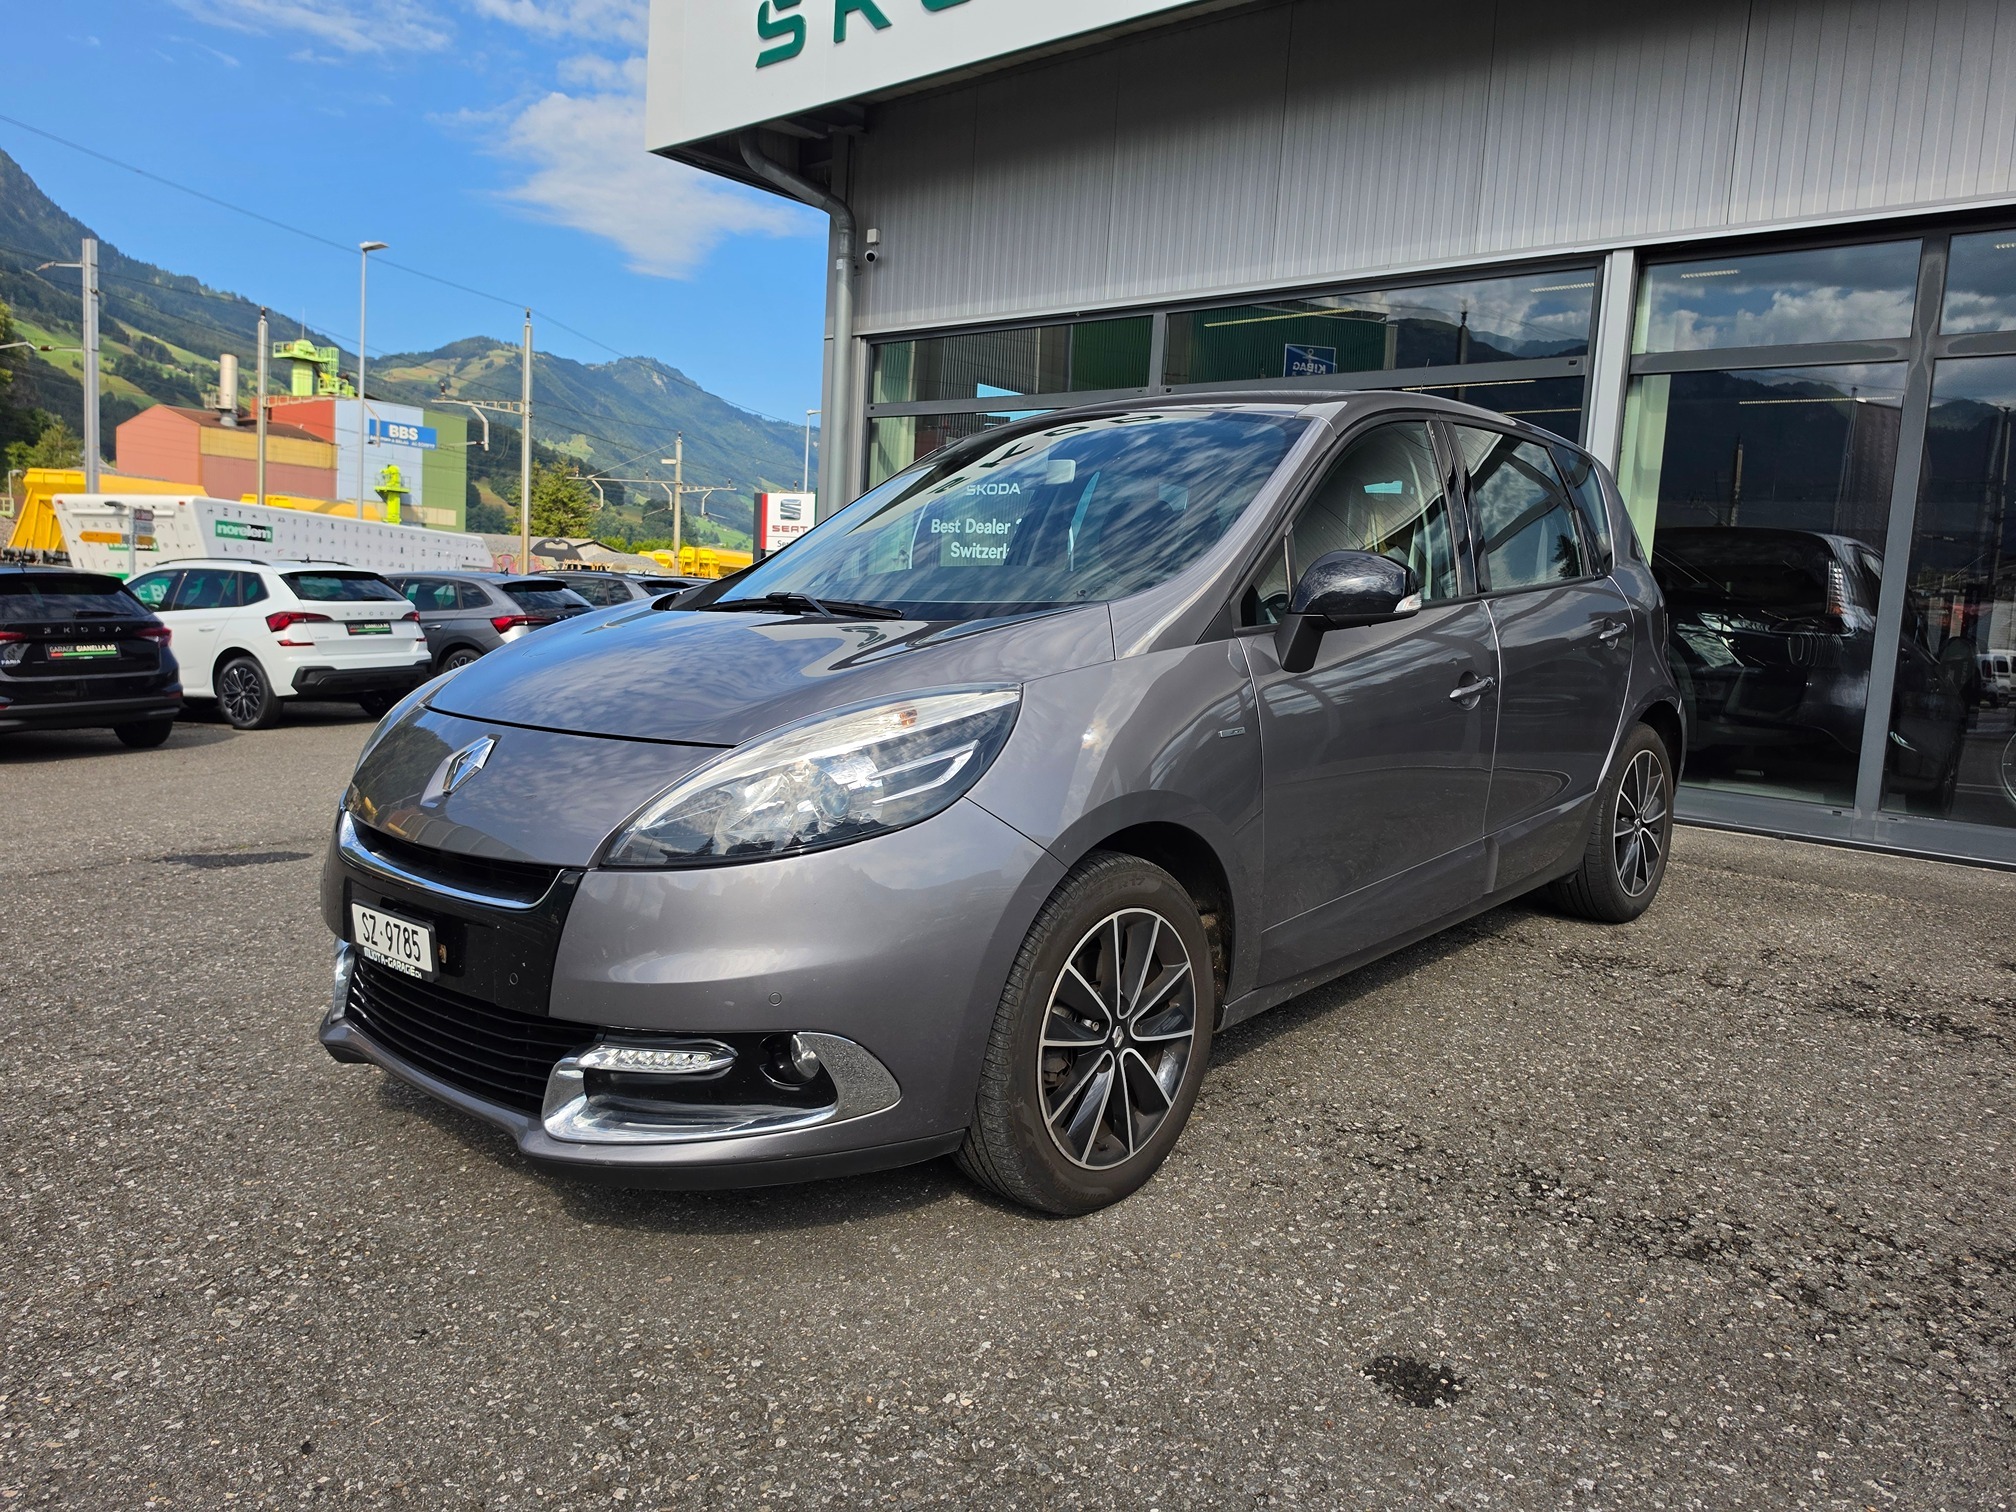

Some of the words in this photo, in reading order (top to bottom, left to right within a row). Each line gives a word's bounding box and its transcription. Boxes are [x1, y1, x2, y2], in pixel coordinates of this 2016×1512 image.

[389, 424, 418, 441] BBS
[772, 525, 808, 533] SEAT
[931, 519, 961, 533] Best
[965, 518, 1011, 534] Dealer
